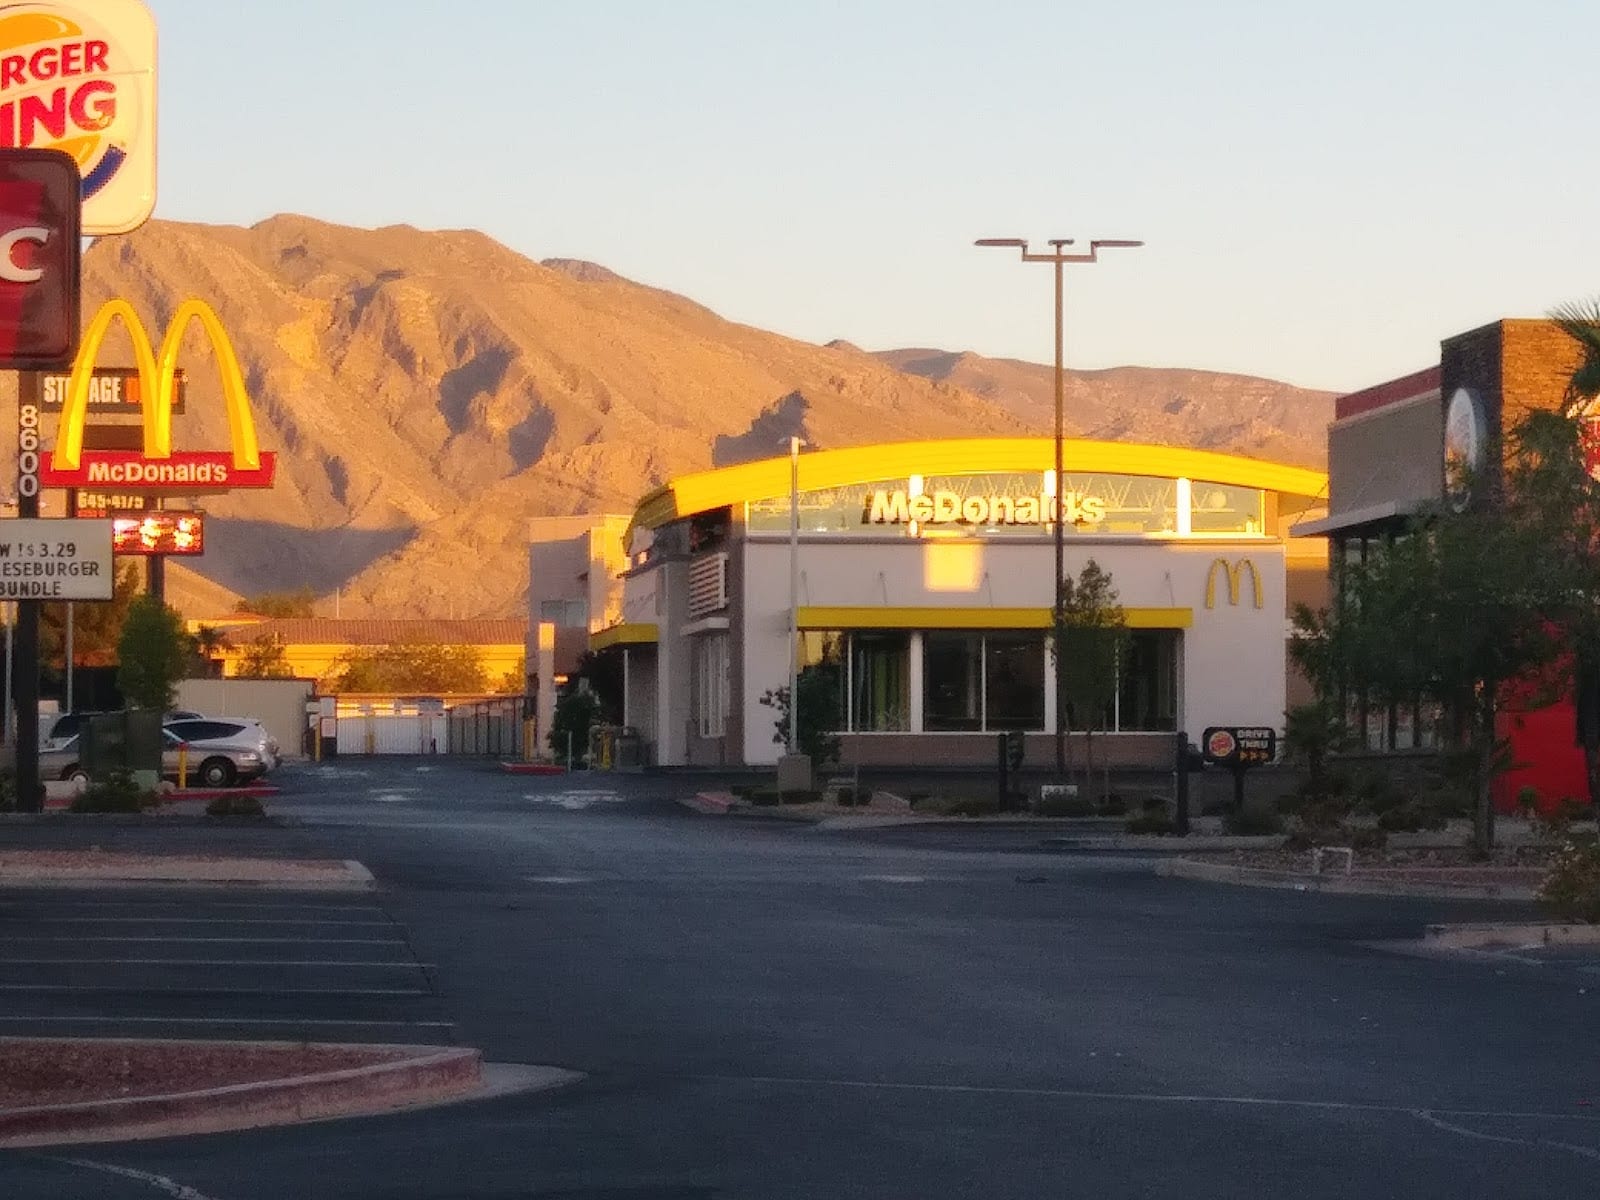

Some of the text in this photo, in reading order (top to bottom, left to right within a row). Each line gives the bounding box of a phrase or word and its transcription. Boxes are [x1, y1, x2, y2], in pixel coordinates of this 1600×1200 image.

[1, 40, 108, 91] RGER
[0, 80, 116, 148] ING
[44, 377, 121, 403] STAGE
[20, 405, 38, 497] 8600
[87, 462, 228, 483] McDonald's
[0, 543, 11, 557] W
[3, 562, 99, 576] ESEBURGER
[0, 581, 62, 596] BUNDLE
